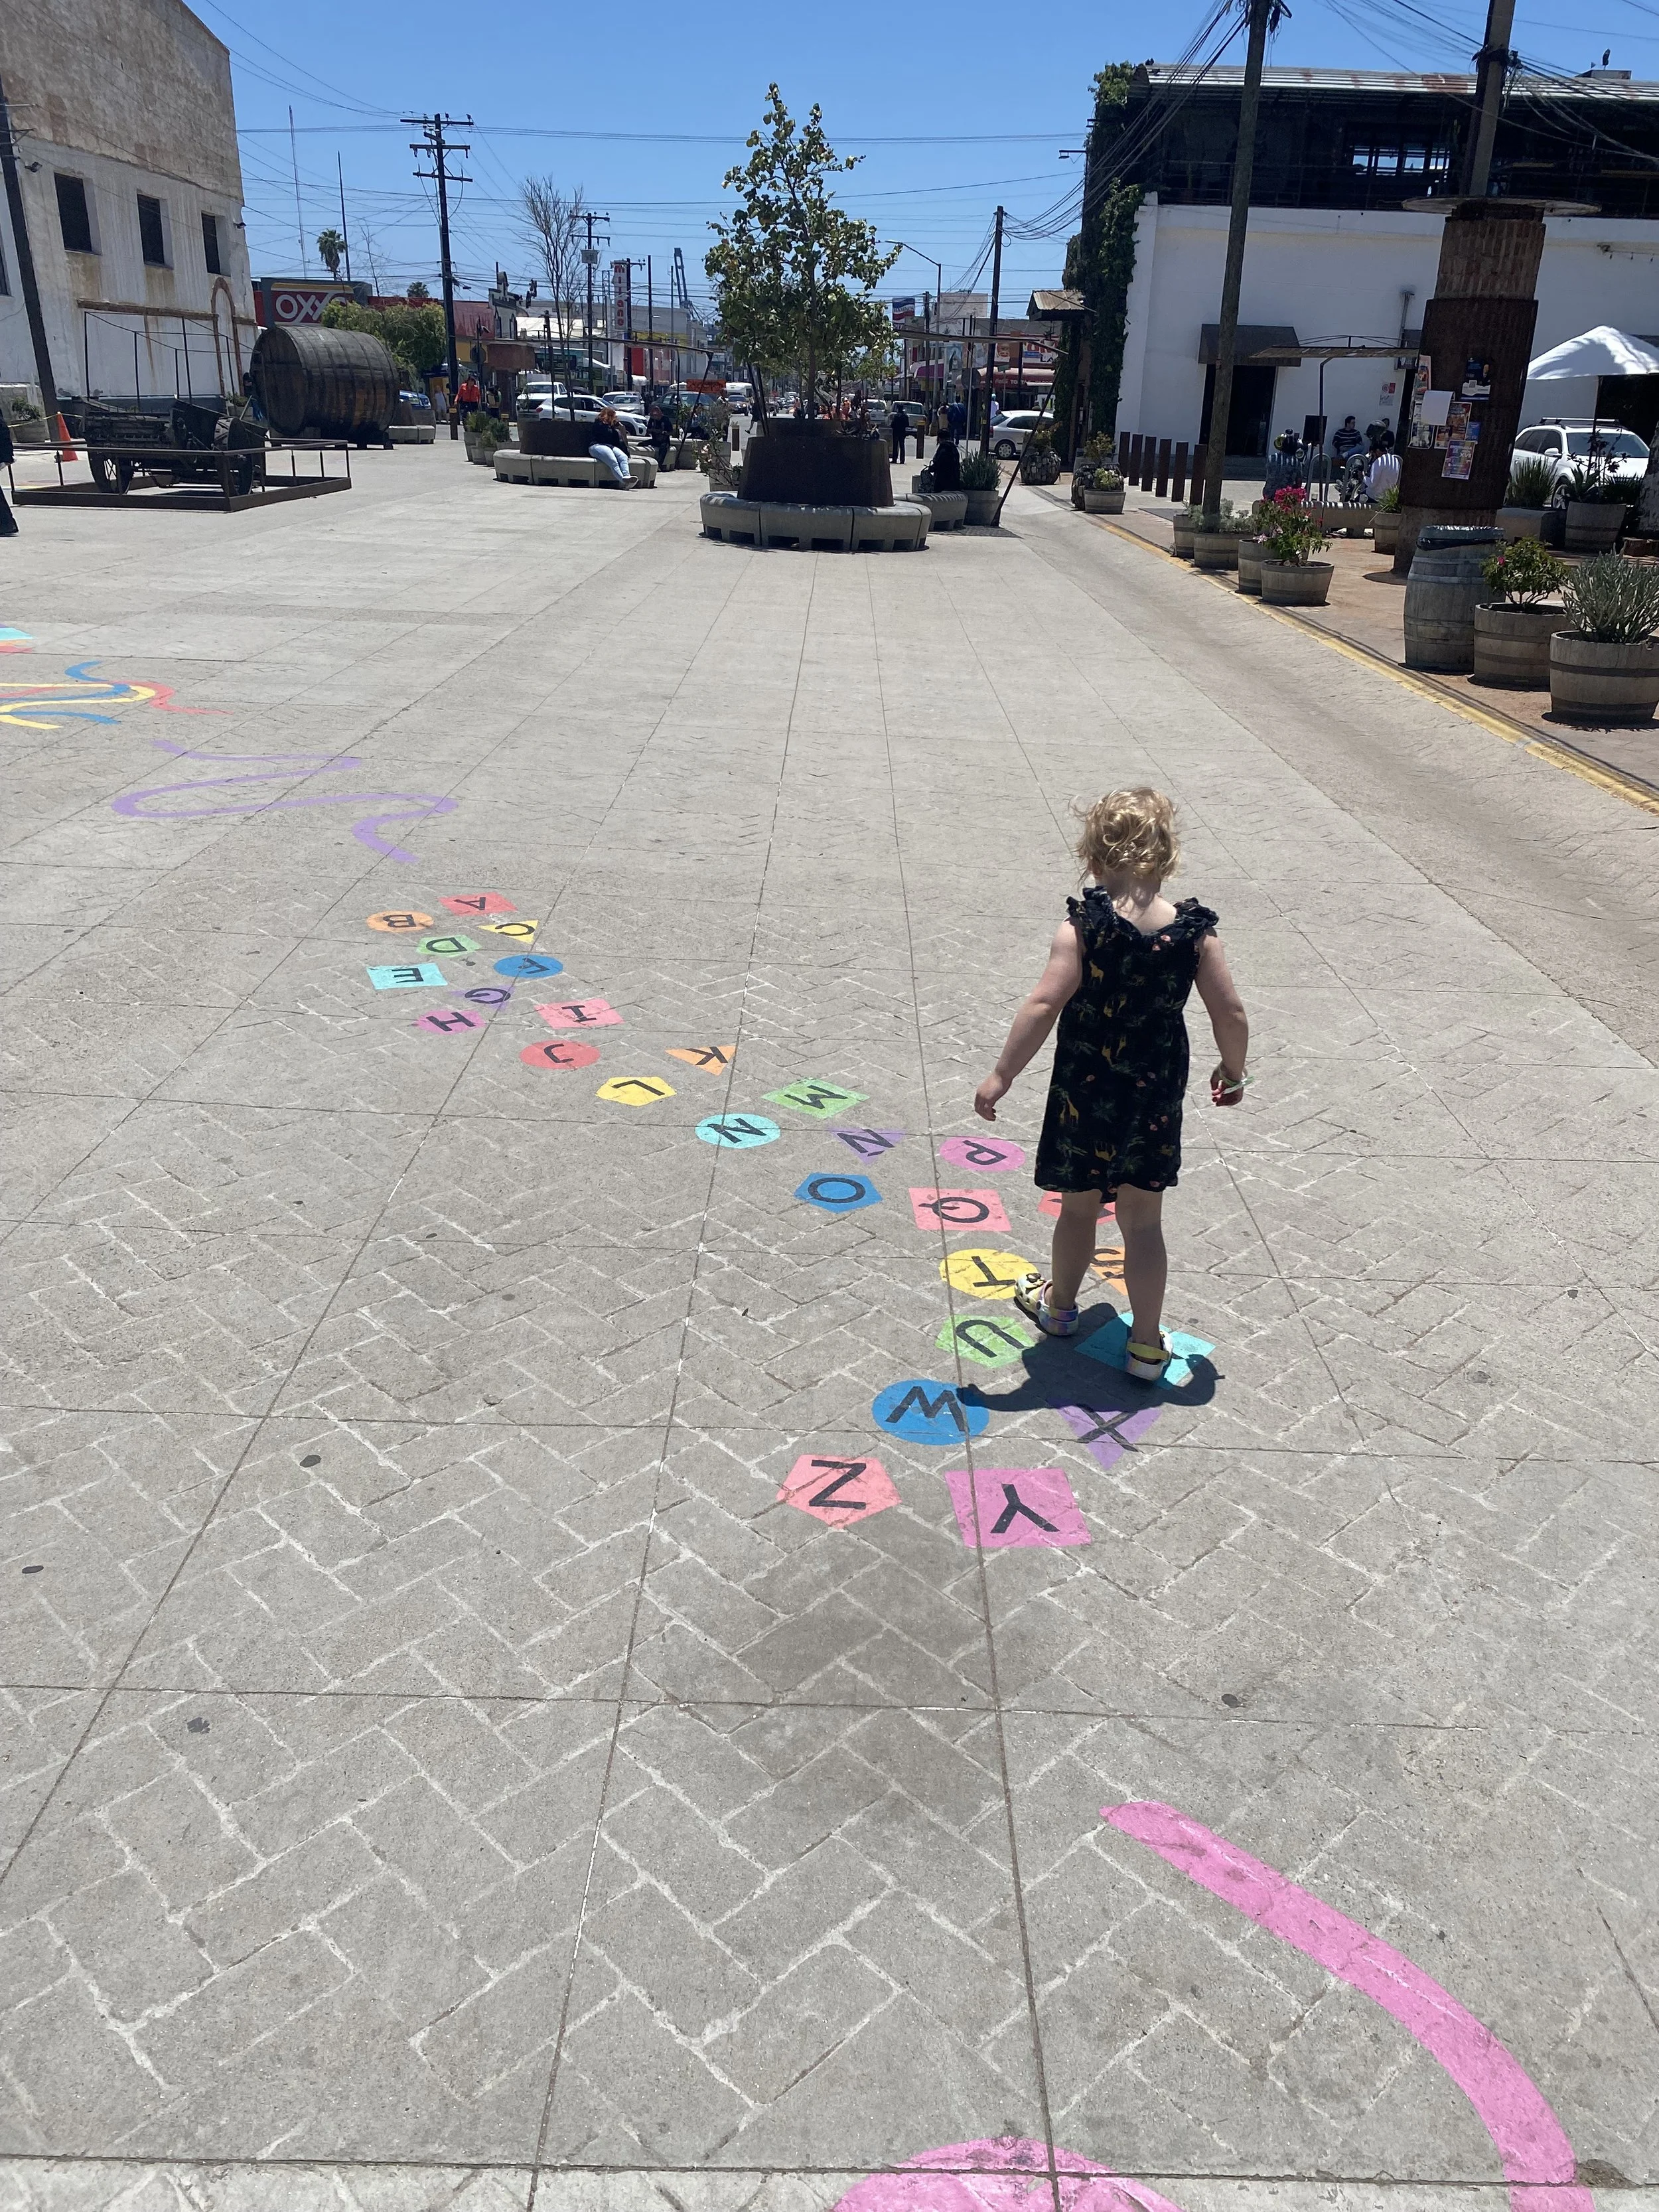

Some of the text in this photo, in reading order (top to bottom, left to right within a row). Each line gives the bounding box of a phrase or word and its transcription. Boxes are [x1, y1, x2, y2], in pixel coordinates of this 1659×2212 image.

[614, 265, 625, 327] milano
[275, 292, 346, 323] OXX
[454, 897, 486, 911] A
[383, 914, 416, 928] B
[494, 922, 535, 936] C
[426, 937, 467, 953] D
[392, 968, 424, 984] E
[518, 958, 550, 974] F
[465, 988, 511, 1004] G
[425, 1011, 476, 1032] H
[561, 1005, 597, 1023] I
[543, 1043, 574, 1064] J
[685, 1046, 729, 1066] K
[613, 1079, 666, 1096] L
[784, 1085, 849, 1109] M
[707, 1118, 766, 1143] N
[962, 1140, 1009, 1165] P
[807, 1177, 866, 1204] O
[918, 1197, 989, 1223] Q
[972, 1256, 1016, 1288] T
[956, 1319, 1027, 1359] U
[1077, 1403, 1139, 1452] X
[809, 1459, 867, 1510] Z
[989, 1483, 1060, 1534] Y
